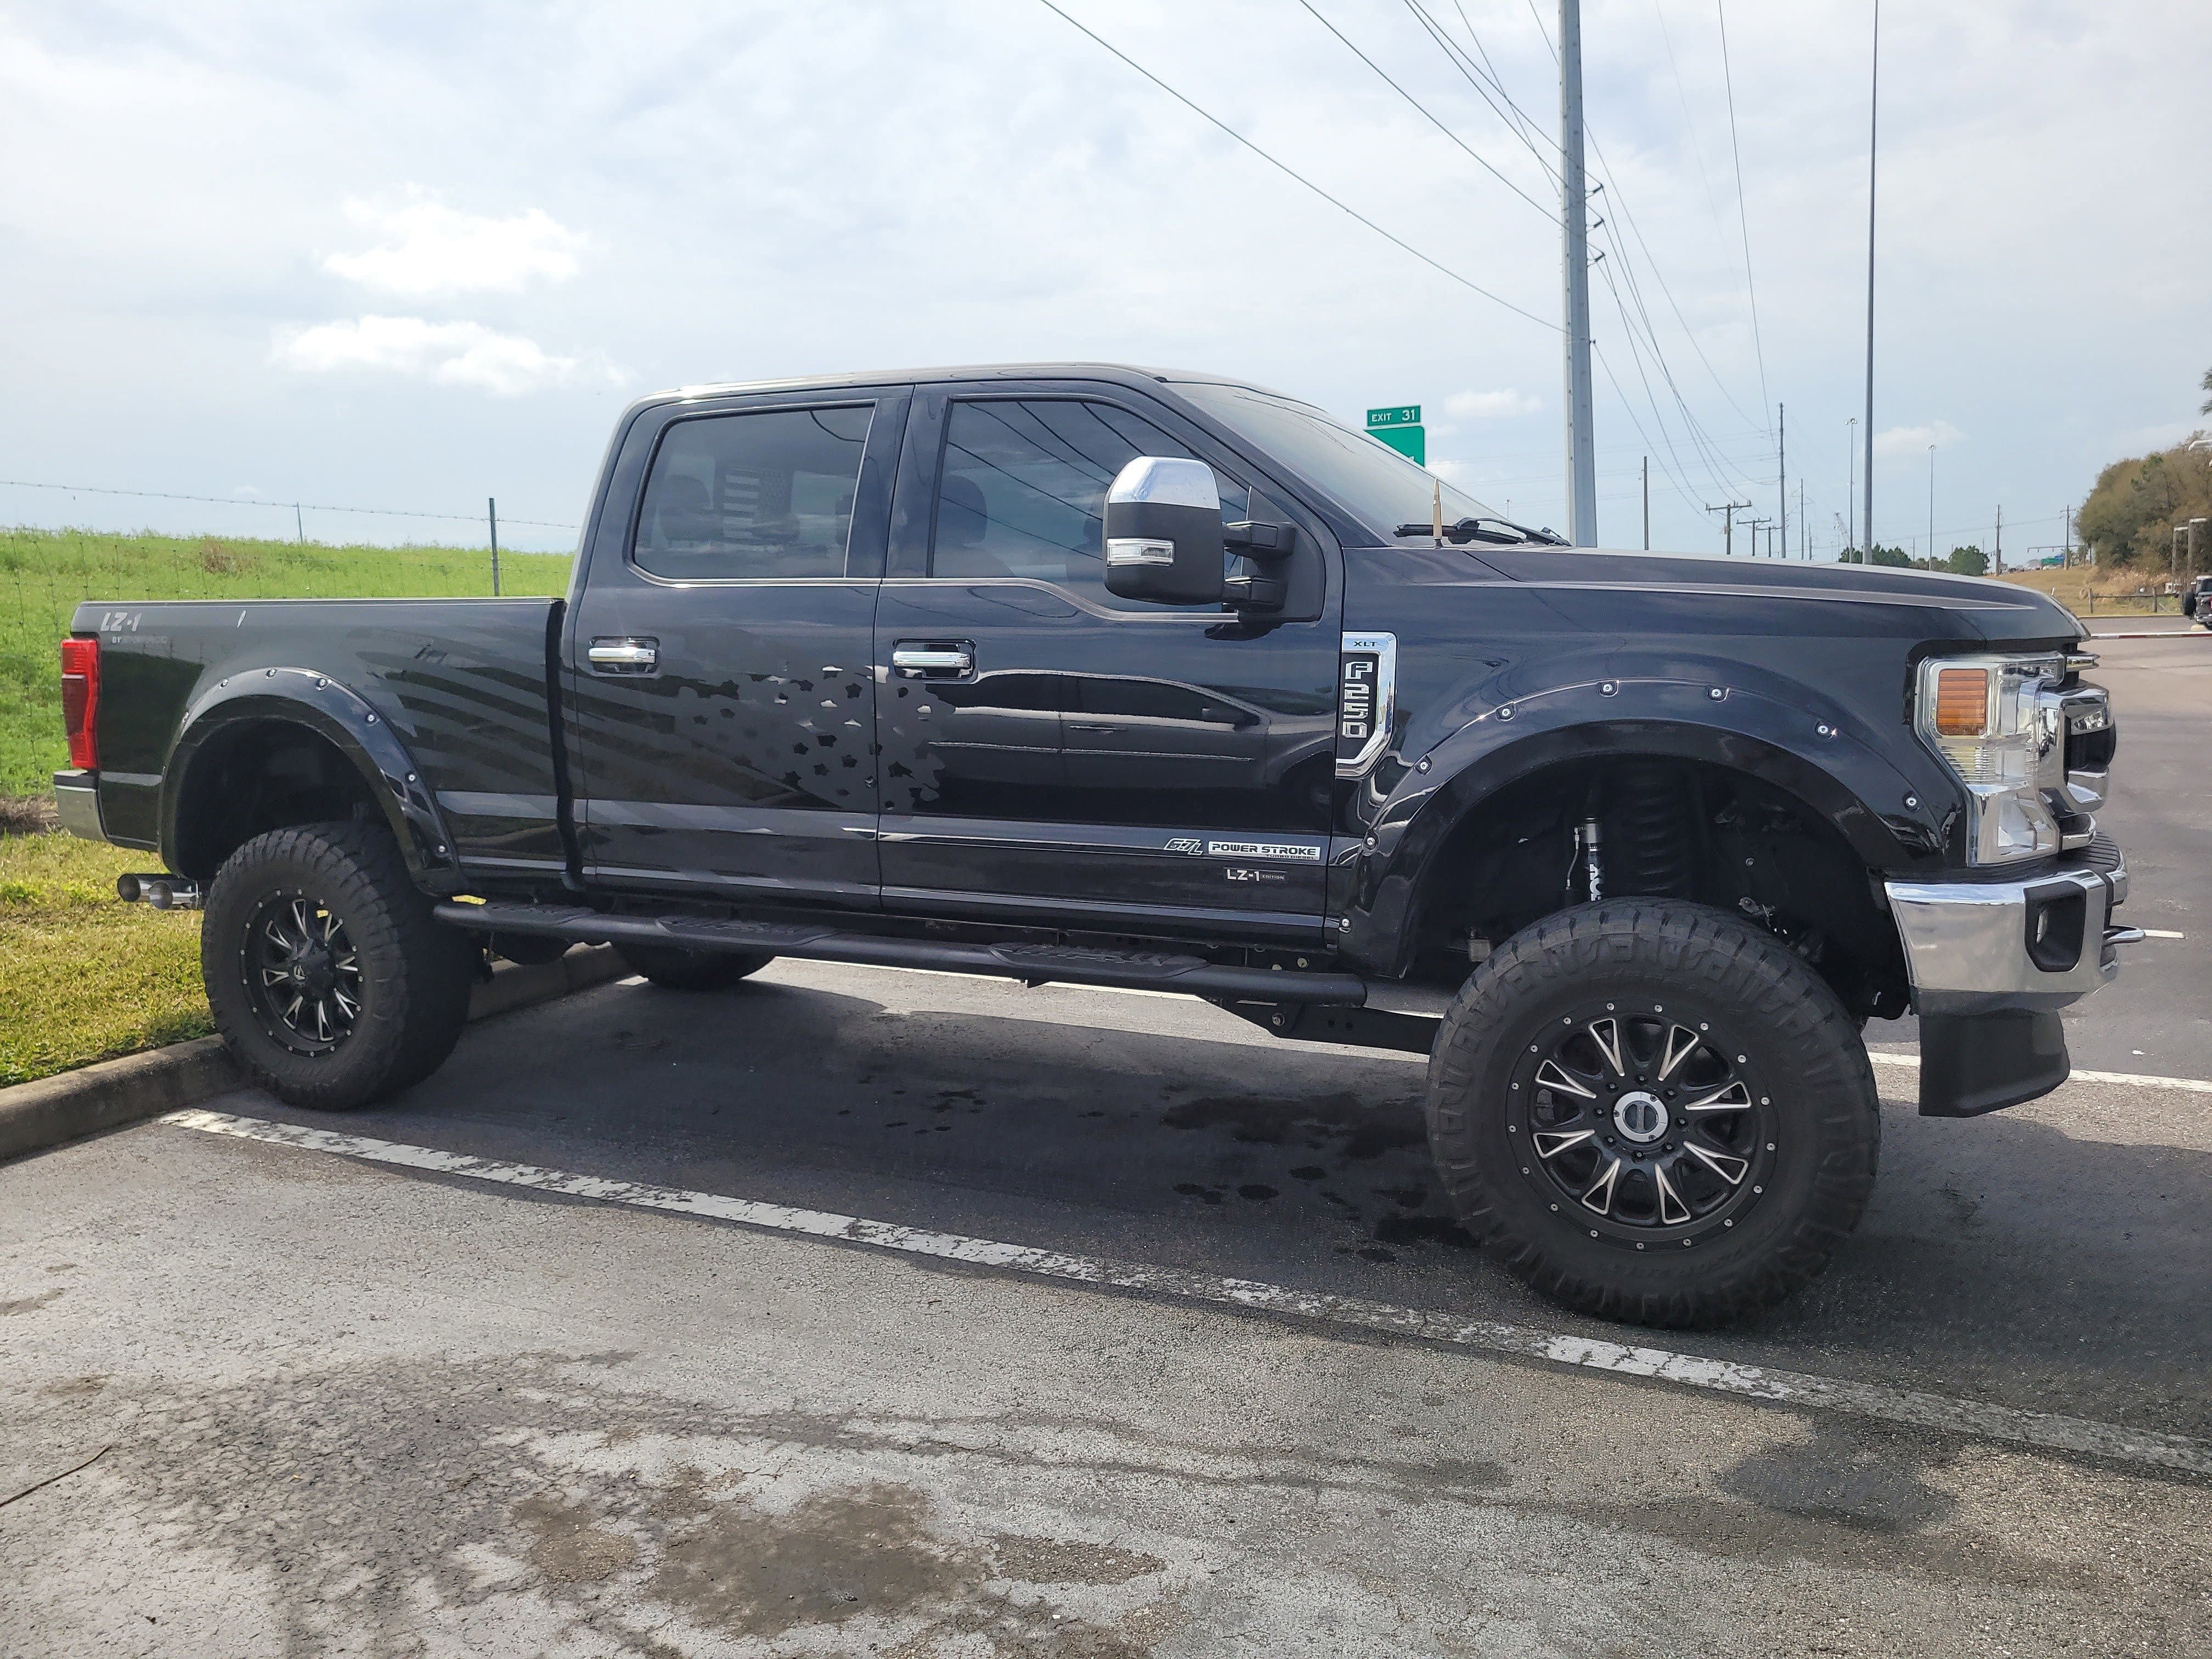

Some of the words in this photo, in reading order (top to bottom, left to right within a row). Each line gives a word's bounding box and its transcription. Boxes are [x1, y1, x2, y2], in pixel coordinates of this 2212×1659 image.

[1372, 413, 1392, 422] EXIT
[1402, 409, 1415, 421] 31
[1163, 838, 1204, 856] 6.7L
[1212, 843, 1258, 853] POWER
[1261, 846, 1316, 856] STROKE
[1227, 869, 1260, 882] LZ-1
